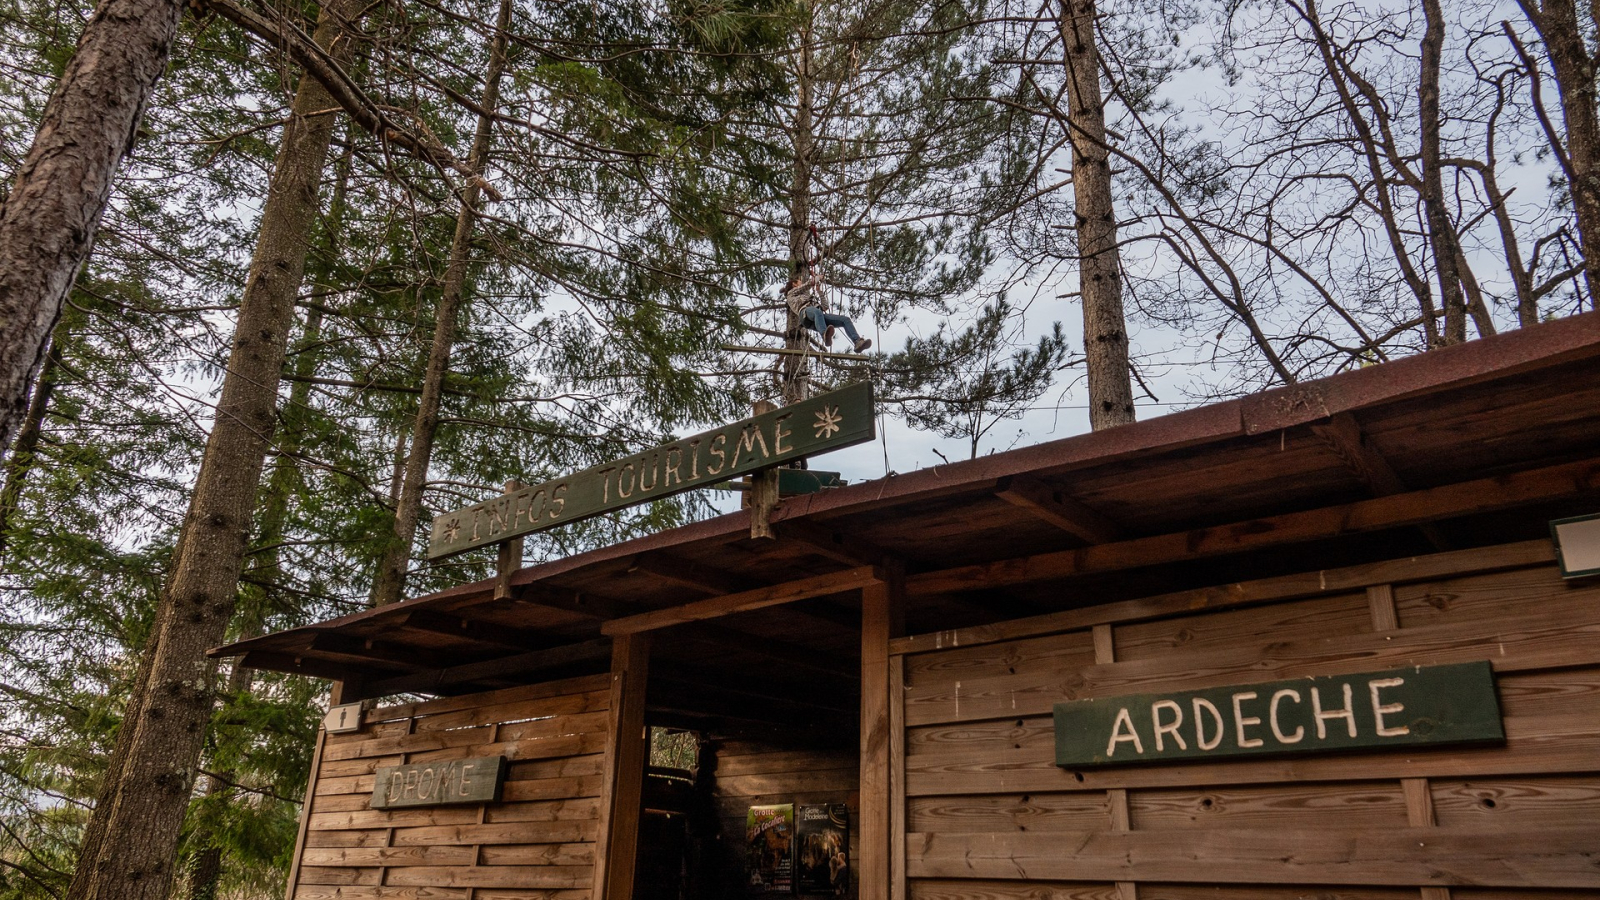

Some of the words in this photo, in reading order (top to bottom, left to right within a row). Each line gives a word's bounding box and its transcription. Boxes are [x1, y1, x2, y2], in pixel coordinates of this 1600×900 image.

[469, 483, 568, 542] INFOS
[598, 411, 794, 504] TOURISME
[1106, 676, 1411, 757] ARDECHE
